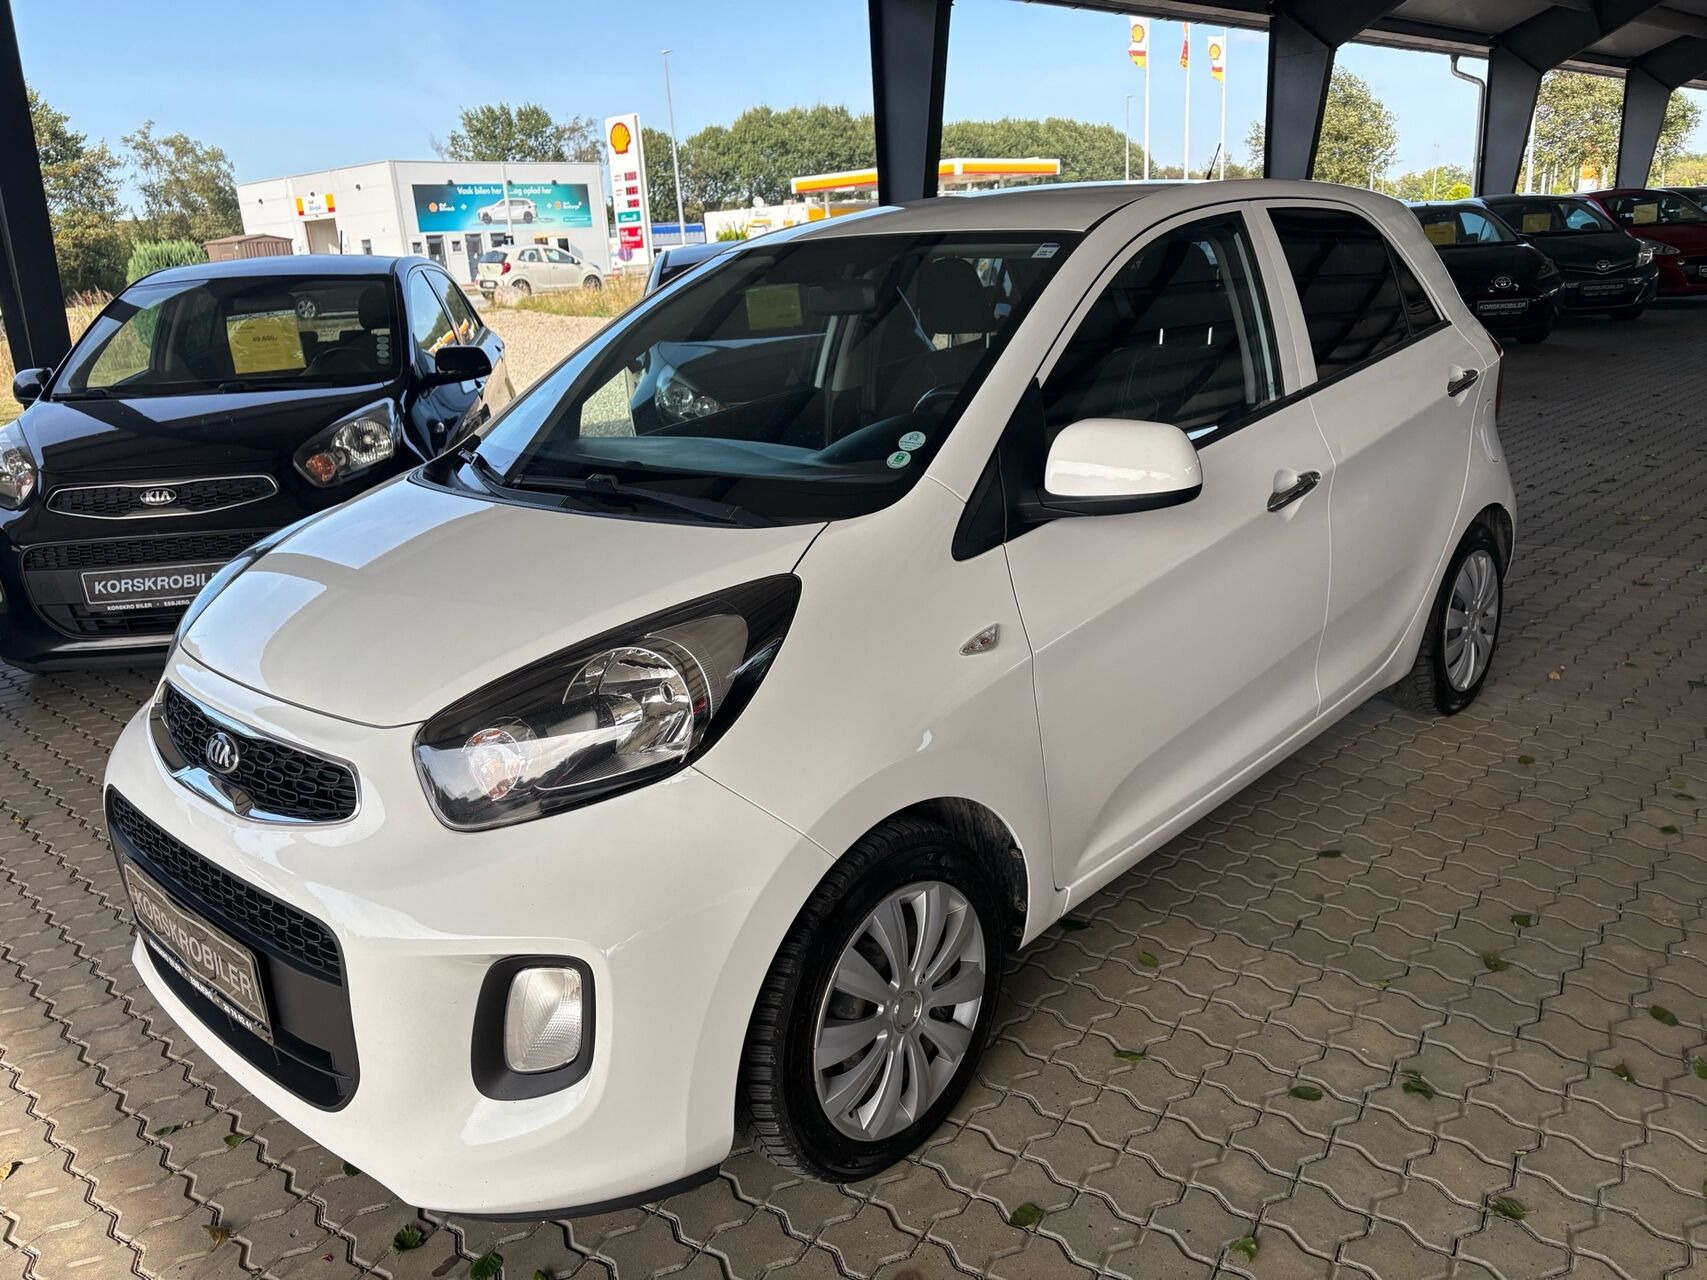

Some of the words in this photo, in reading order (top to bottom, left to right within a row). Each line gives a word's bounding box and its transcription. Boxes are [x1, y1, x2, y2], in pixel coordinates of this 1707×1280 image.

[474, 186, 490, 195] bilen
[491, 186, 502, 195] her
[541, 186, 552, 194] her
[145, 490, 171, 502] KIA
[94, 572, 215, 595] KORSKROBIL
[207, 737, 230, 768] KIA
[135, 890, 254, 1001] KORSKROBILER
